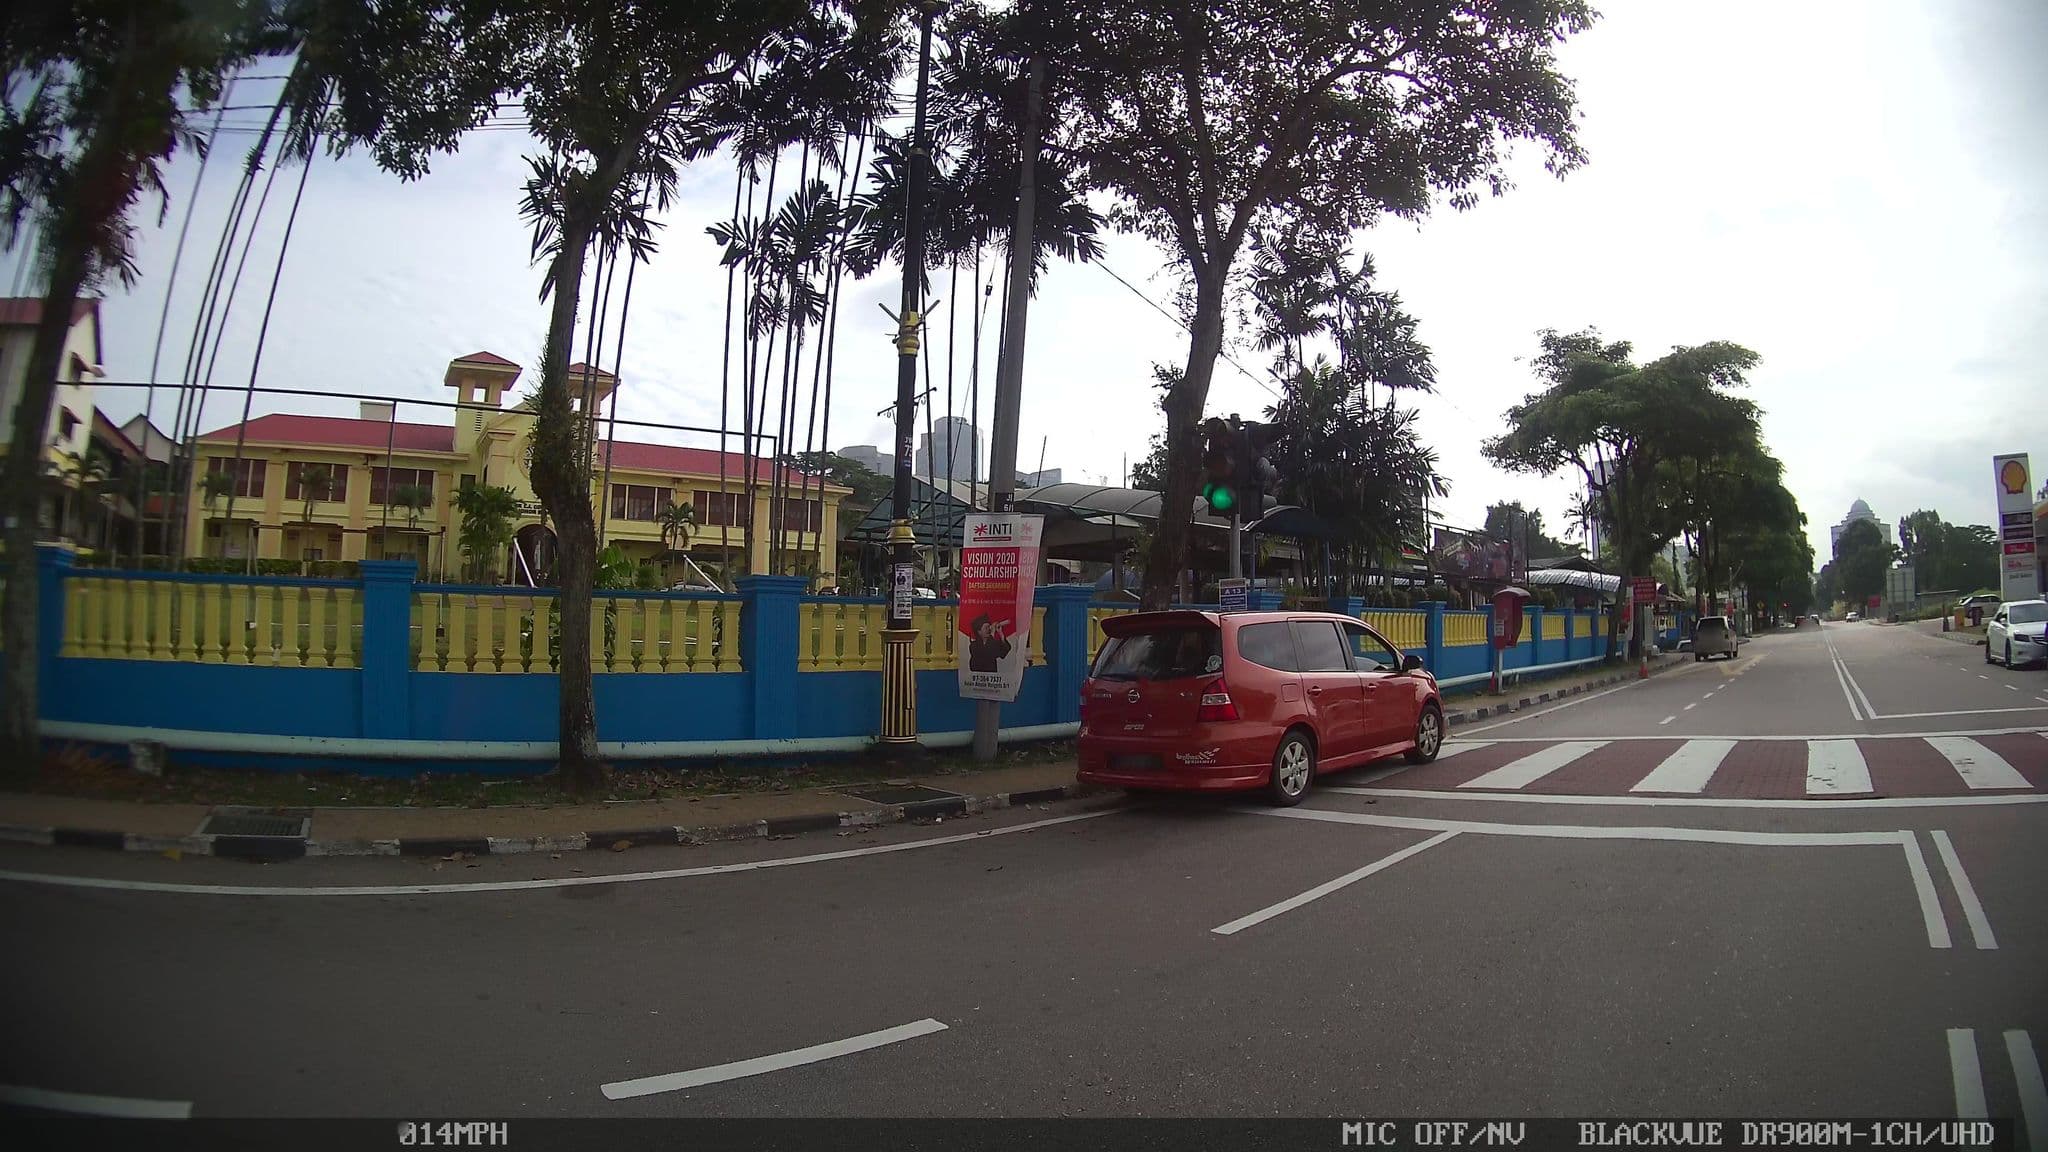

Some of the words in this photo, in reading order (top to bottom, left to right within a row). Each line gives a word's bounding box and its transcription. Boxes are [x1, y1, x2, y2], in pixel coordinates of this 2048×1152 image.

[989, 523, 1012, 535] INTI
[967, 552, 994, 564] VISION
[996, 552, 1016, 564] 2020
[963, 566, 1018, 579] SCHOLARSHIP
